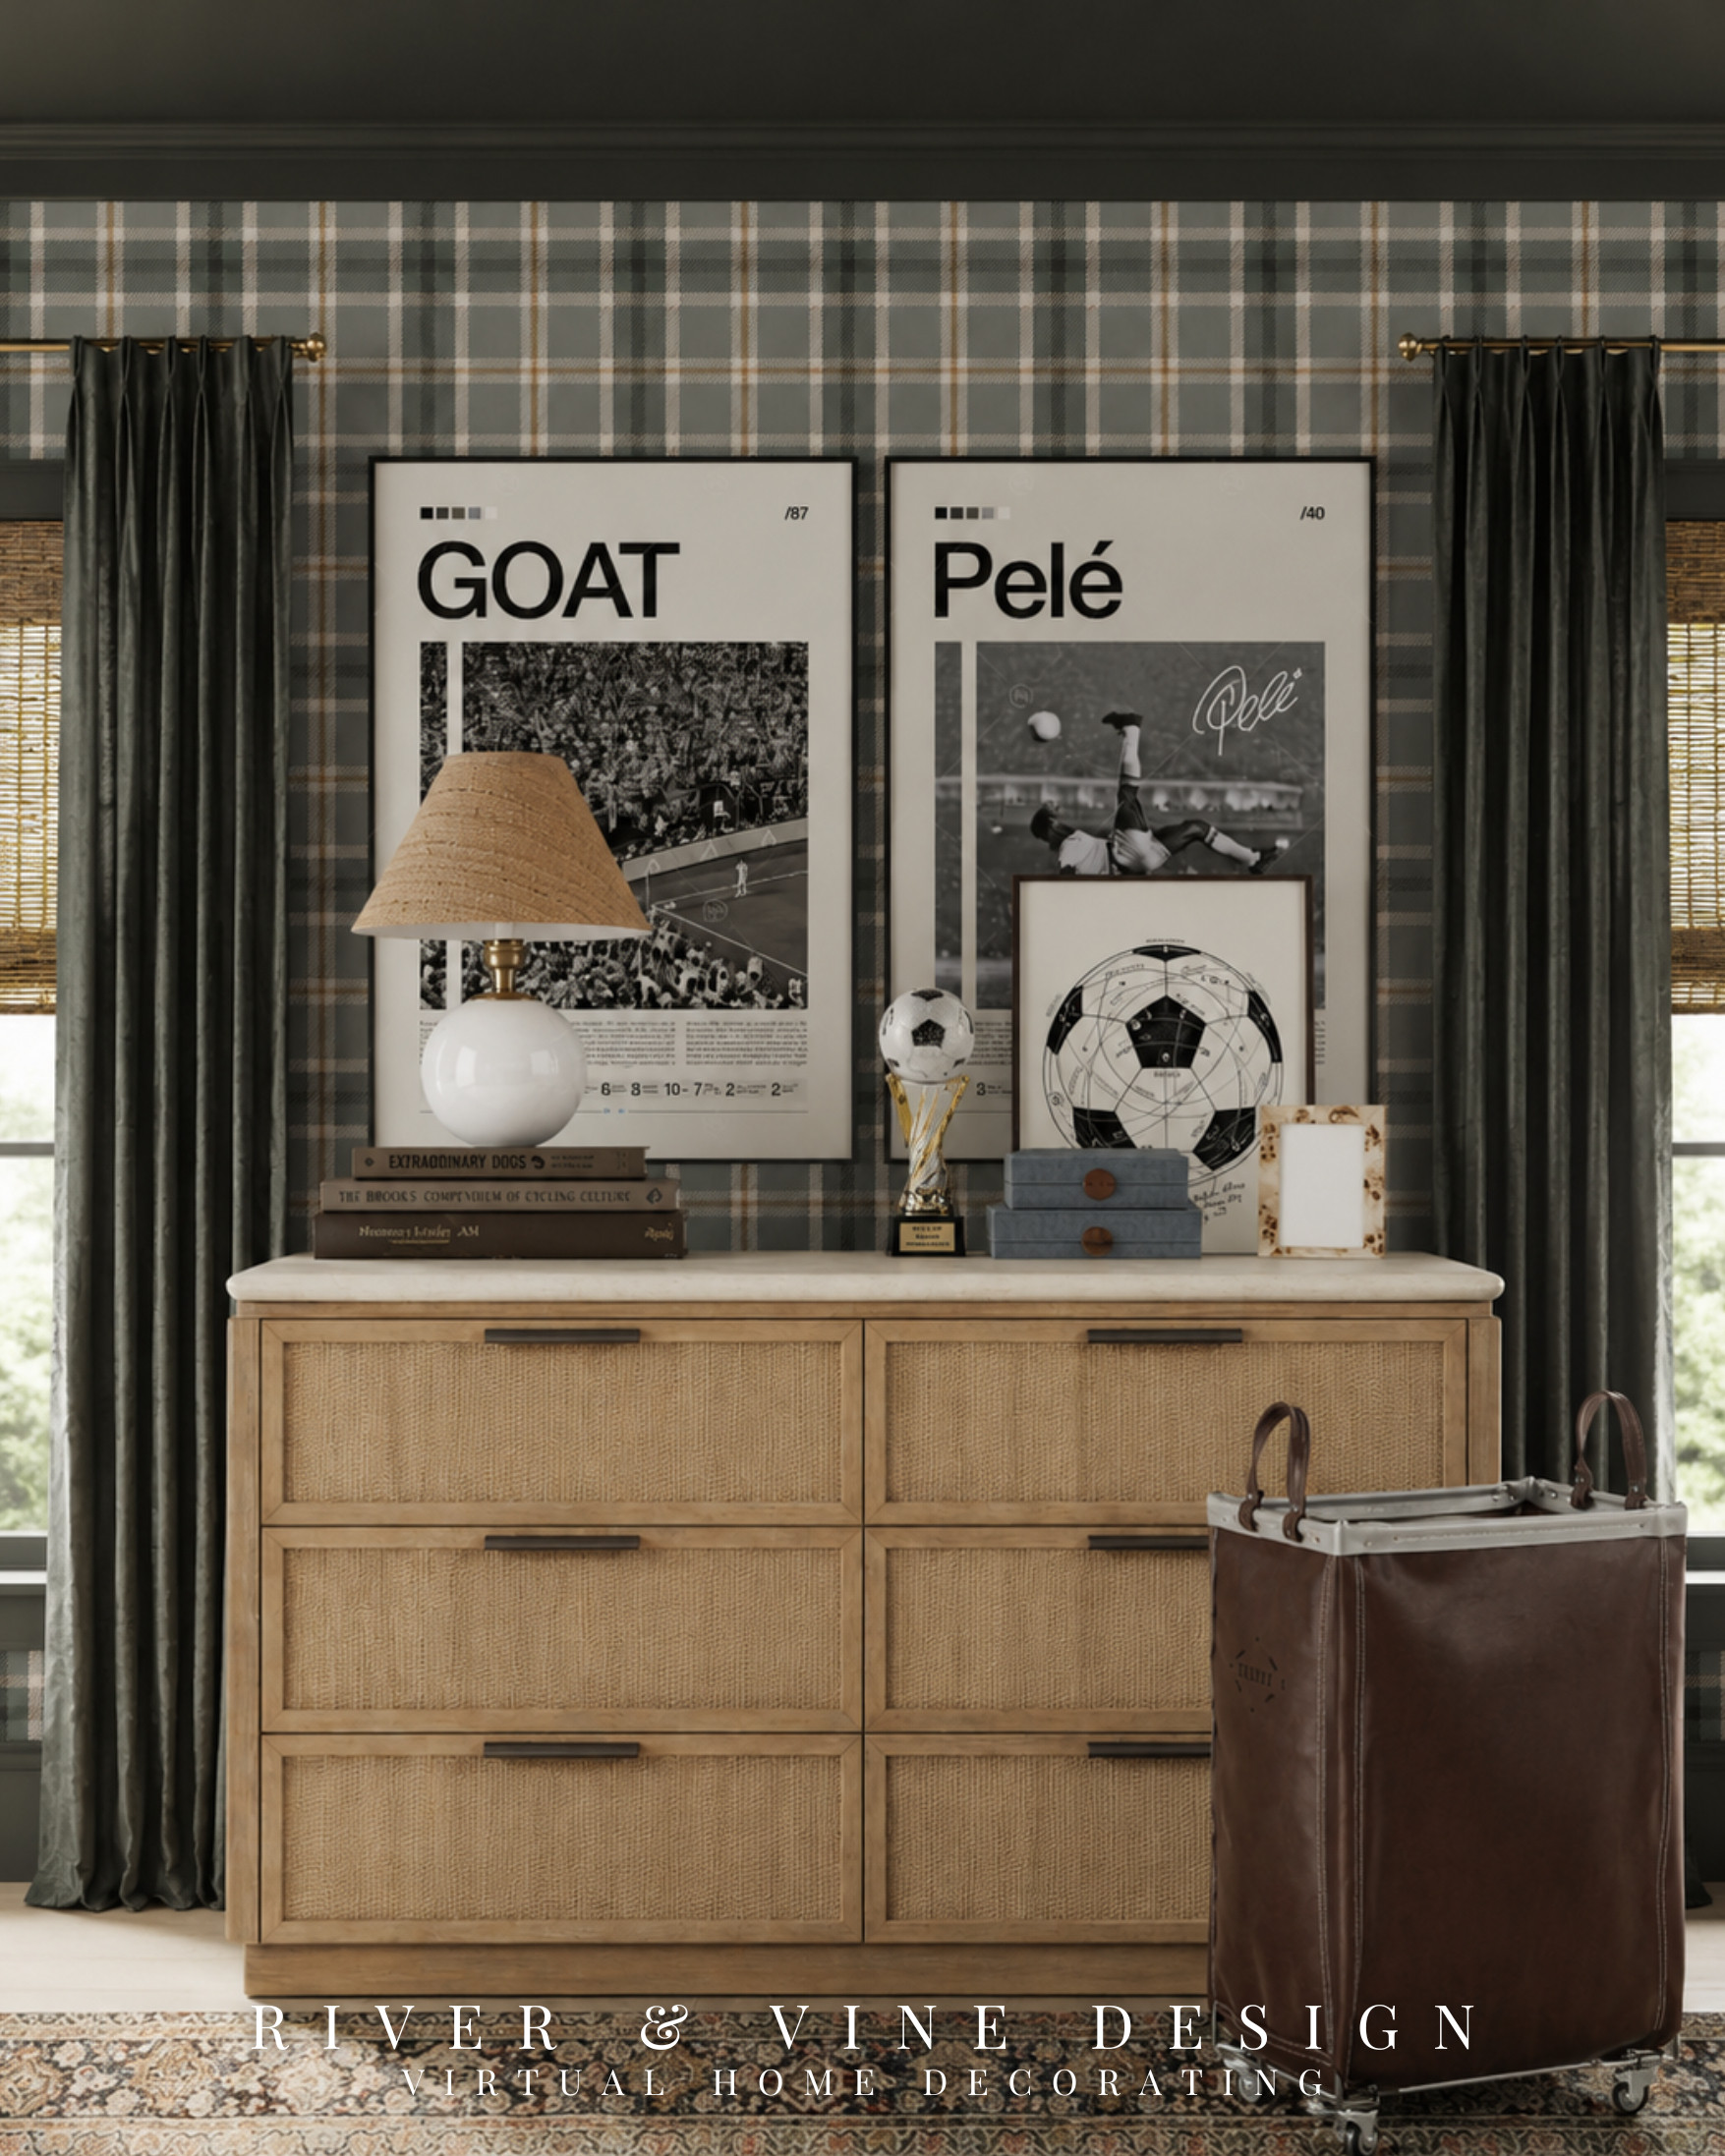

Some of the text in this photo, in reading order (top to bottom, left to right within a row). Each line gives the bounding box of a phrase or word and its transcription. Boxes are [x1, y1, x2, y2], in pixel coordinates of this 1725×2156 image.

[784, 506, 809, 521] /87
[1299, 506, 1326, 521] /40
[417, 540, 681, 620] GOAT
[934, 539, 1123, 620] Pelé
[601, 1082, 611, 1097] 6
[631, 1082, 641, 1097] 8
[724, 1082, 735, 1097] 2
[771, 1082, 781, 1097] 2
[976, 1082, 986, 1096] 3
[491, 1154, 527, 1169] DOGS
[366, 1190, 418, 1203] BROOKS
